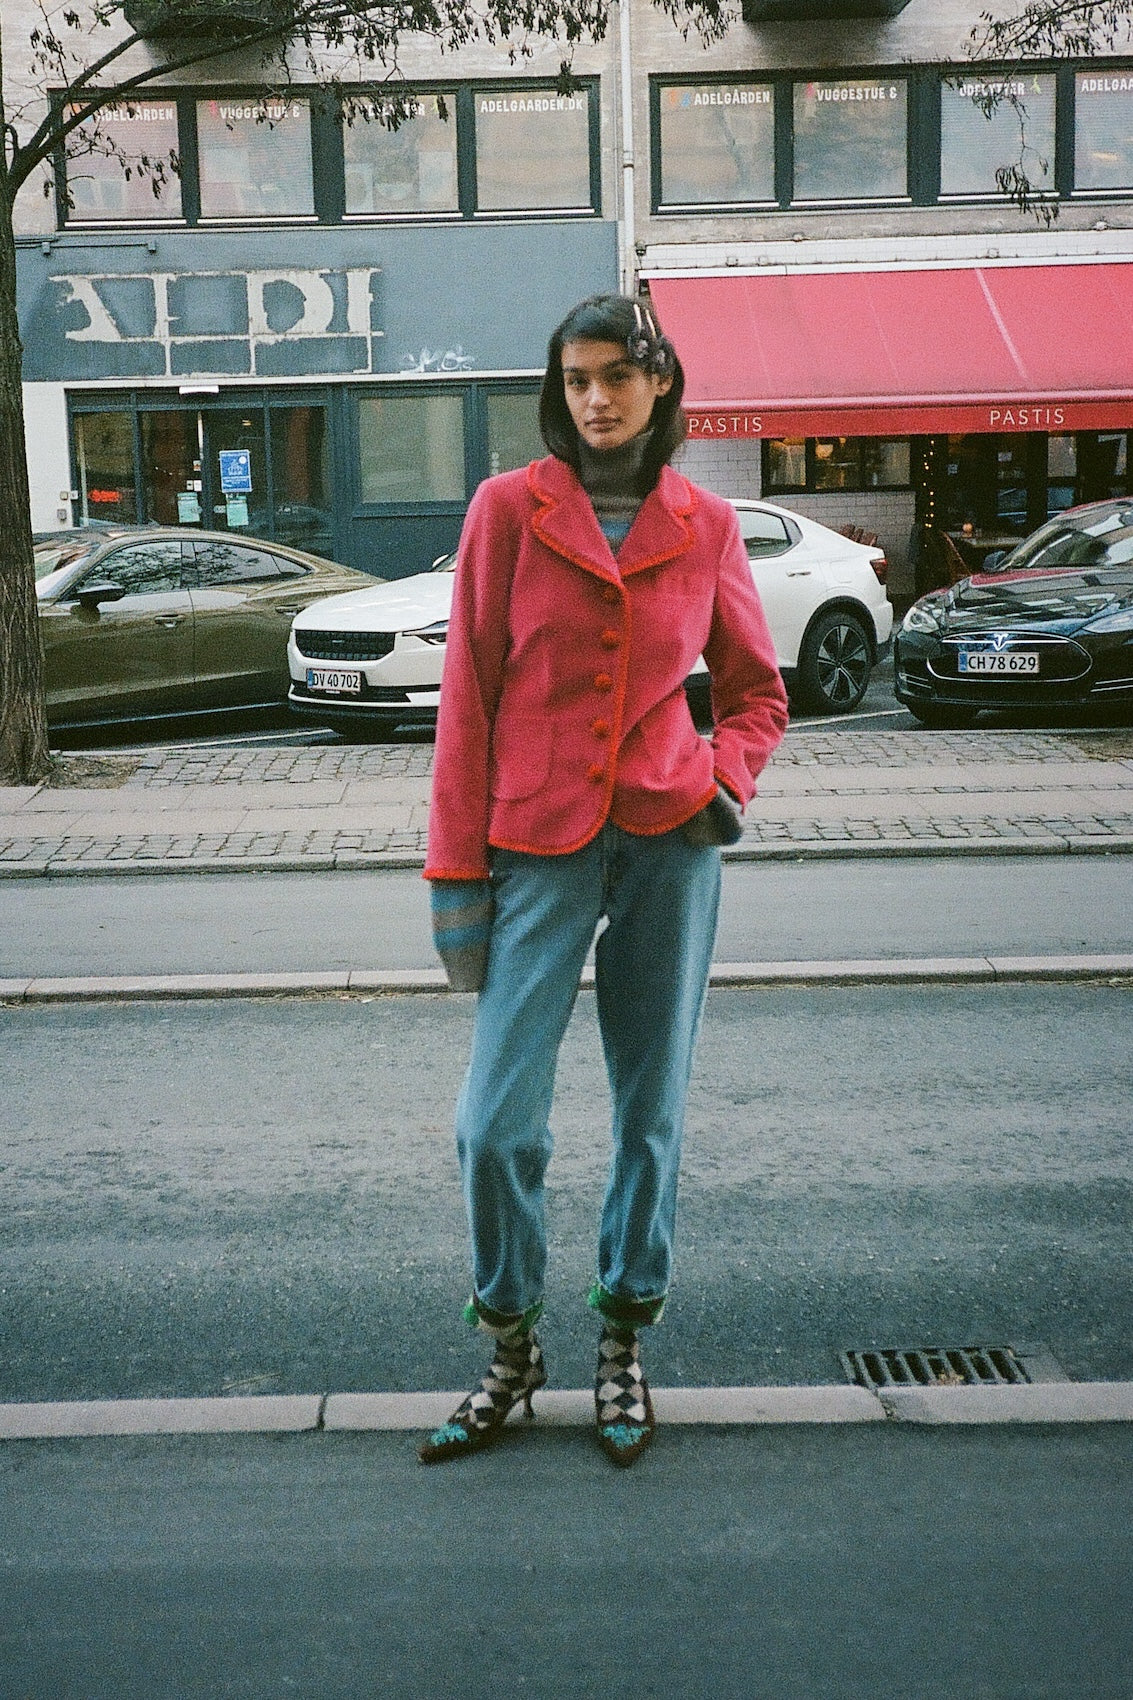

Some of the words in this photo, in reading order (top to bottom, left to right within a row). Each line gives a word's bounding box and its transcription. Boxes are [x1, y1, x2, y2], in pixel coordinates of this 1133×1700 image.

[693, 89, 771, 106] ADELGÅRDEN
[816, 87, 886, 101] VUGGESTUE
[889, 86, 898, 100] &
[292, 105, 300, 118] &
[480, 98, 584, 113] ADELGAARDEN.DK
[688, 416, 763, 433] PASTIS
[989, 408, 1065, 426] PASTIS
[968, 656, 986, 670] CH
[989, 656, 1006, 670] 78
[1009, 656, 1036, 671] 629
[313, 673, 325, 686] DV
[327, 673, 339, 687] 40
[340, 674, 358, 688] 702
